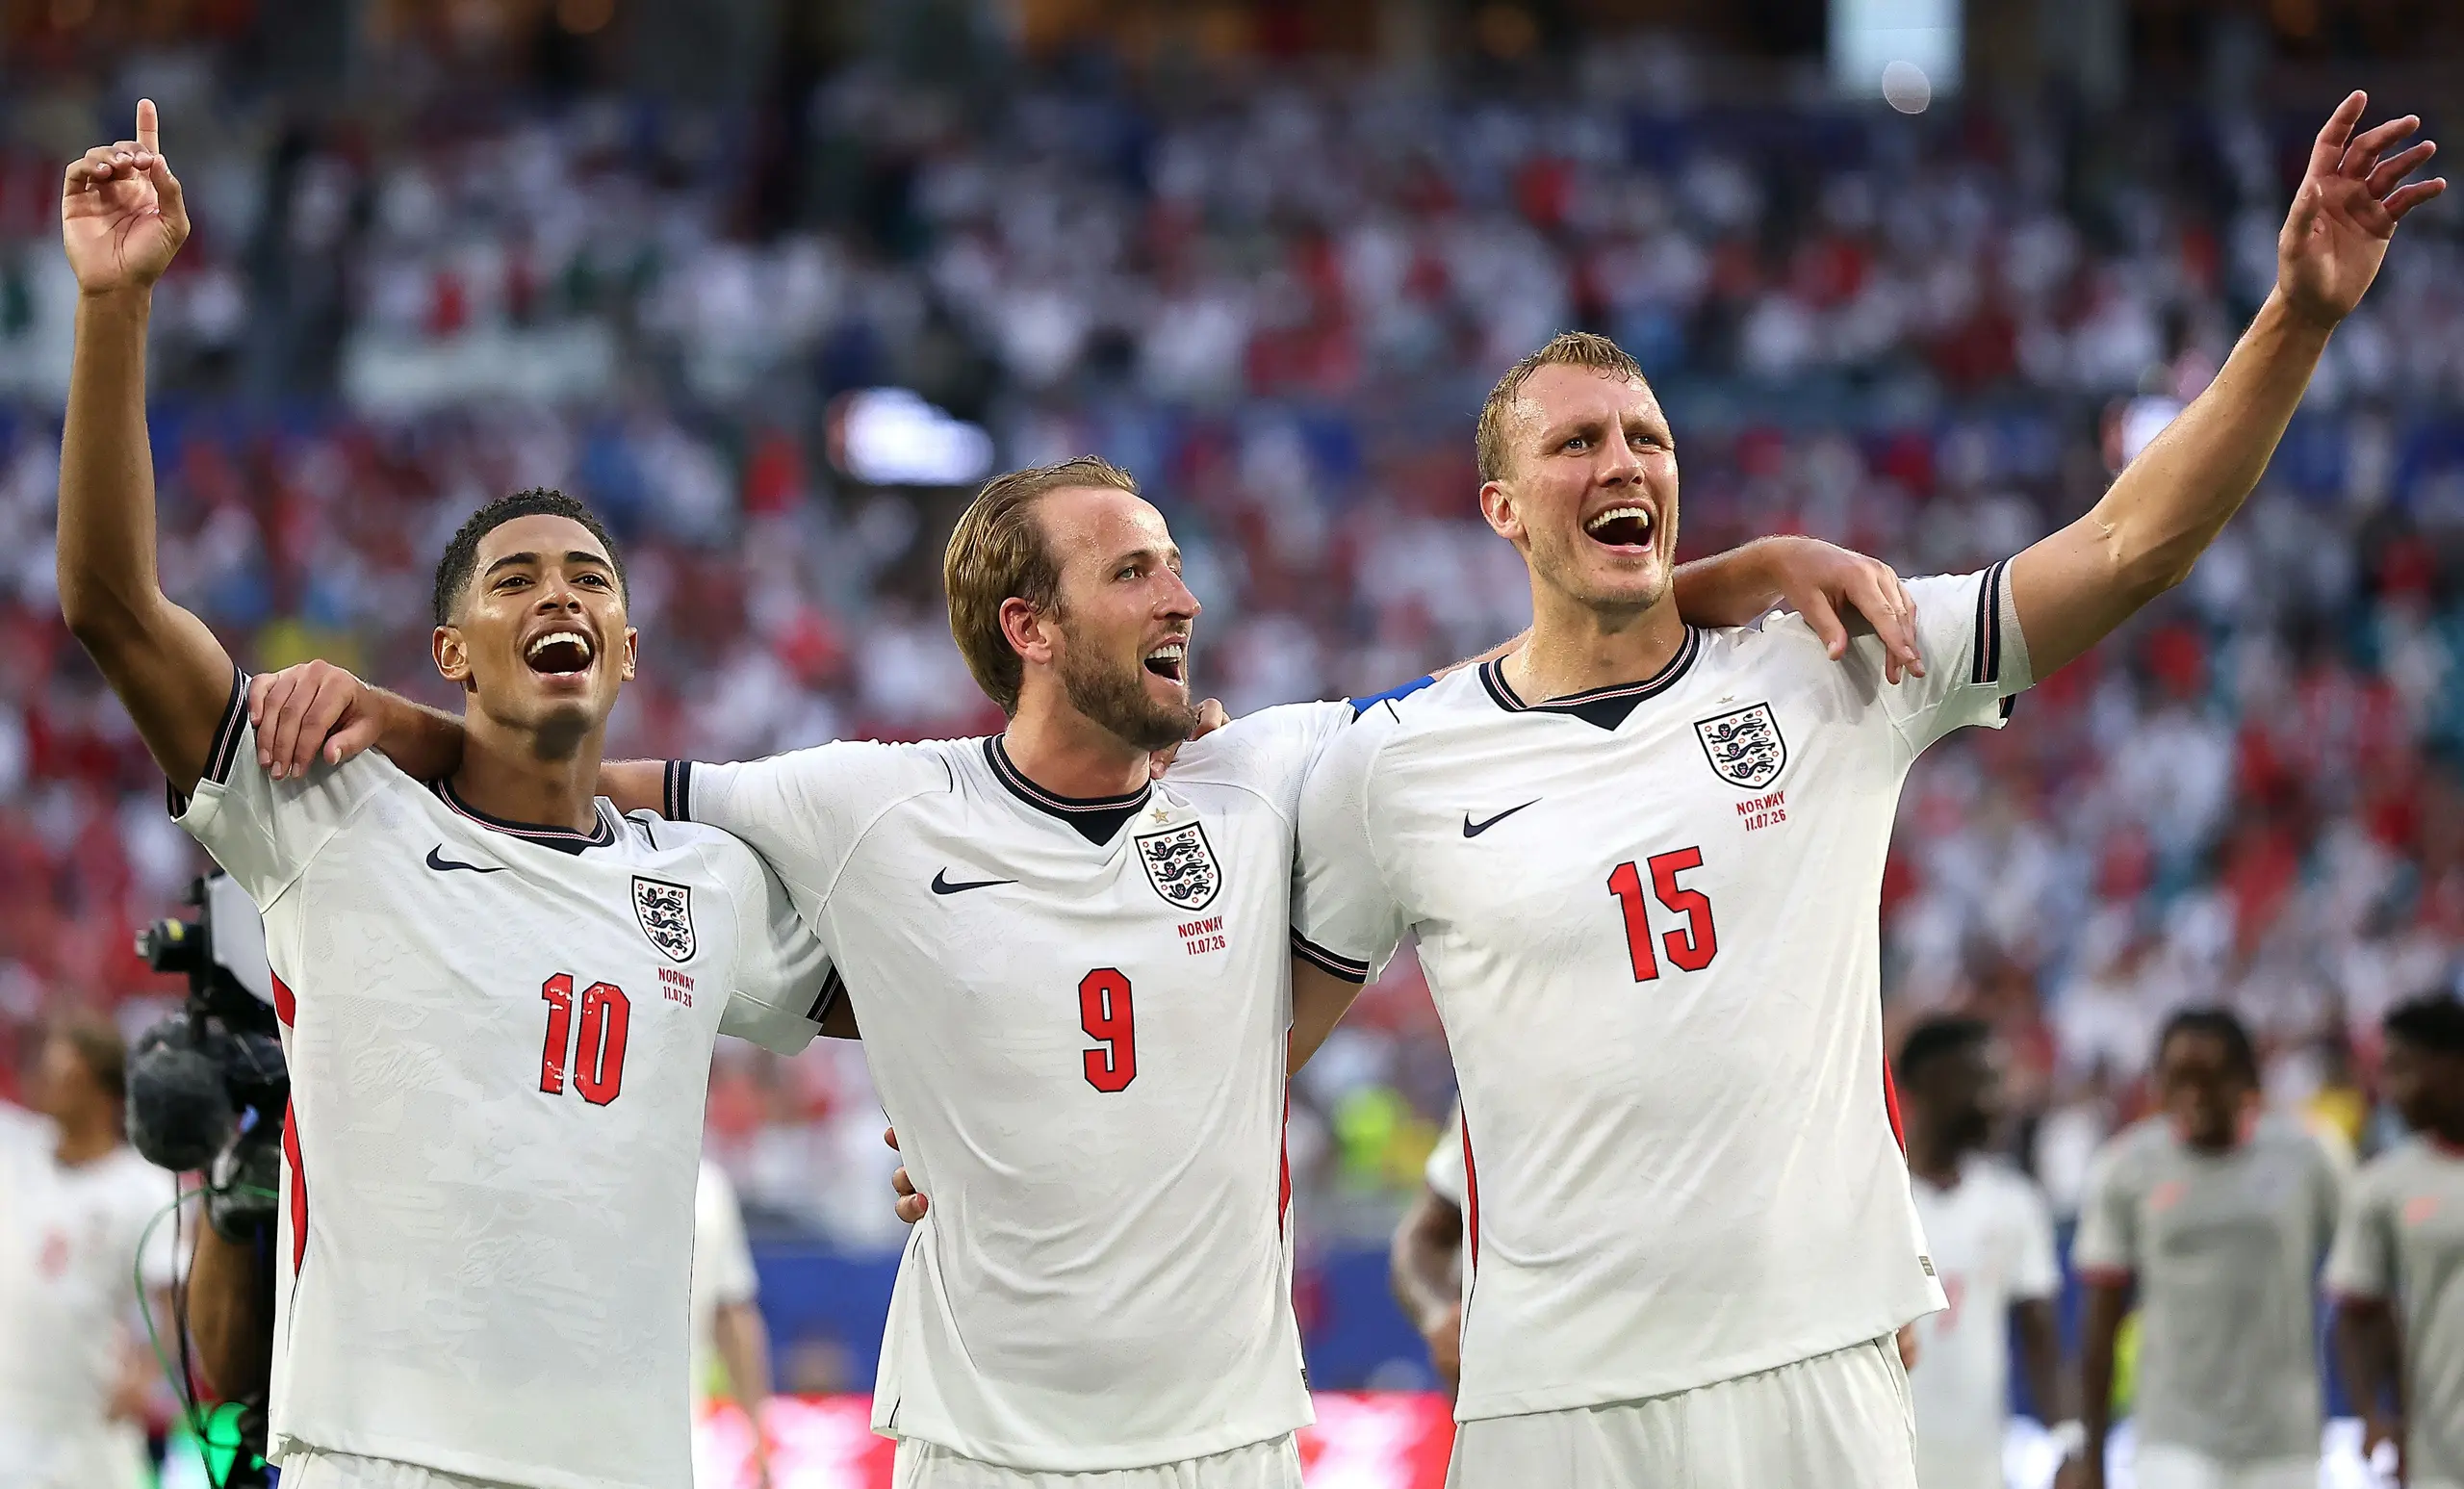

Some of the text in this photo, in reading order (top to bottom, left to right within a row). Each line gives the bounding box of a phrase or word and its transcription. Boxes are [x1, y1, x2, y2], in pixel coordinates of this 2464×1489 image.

[1736, 790, 1785, 816] NORWAY
[1745, 809, 1786, 832] 11.07.26
[1177, 915, 1223, 938] NORWAY
[1606, 845, 1718, 983] 15
[1187, 935, 1225, 956] 11.07.26
[657, 966, 695, 991] NORWAY
[540, 972, 630, 1107] 10
[1078, 966, 1137, 1093] 9
